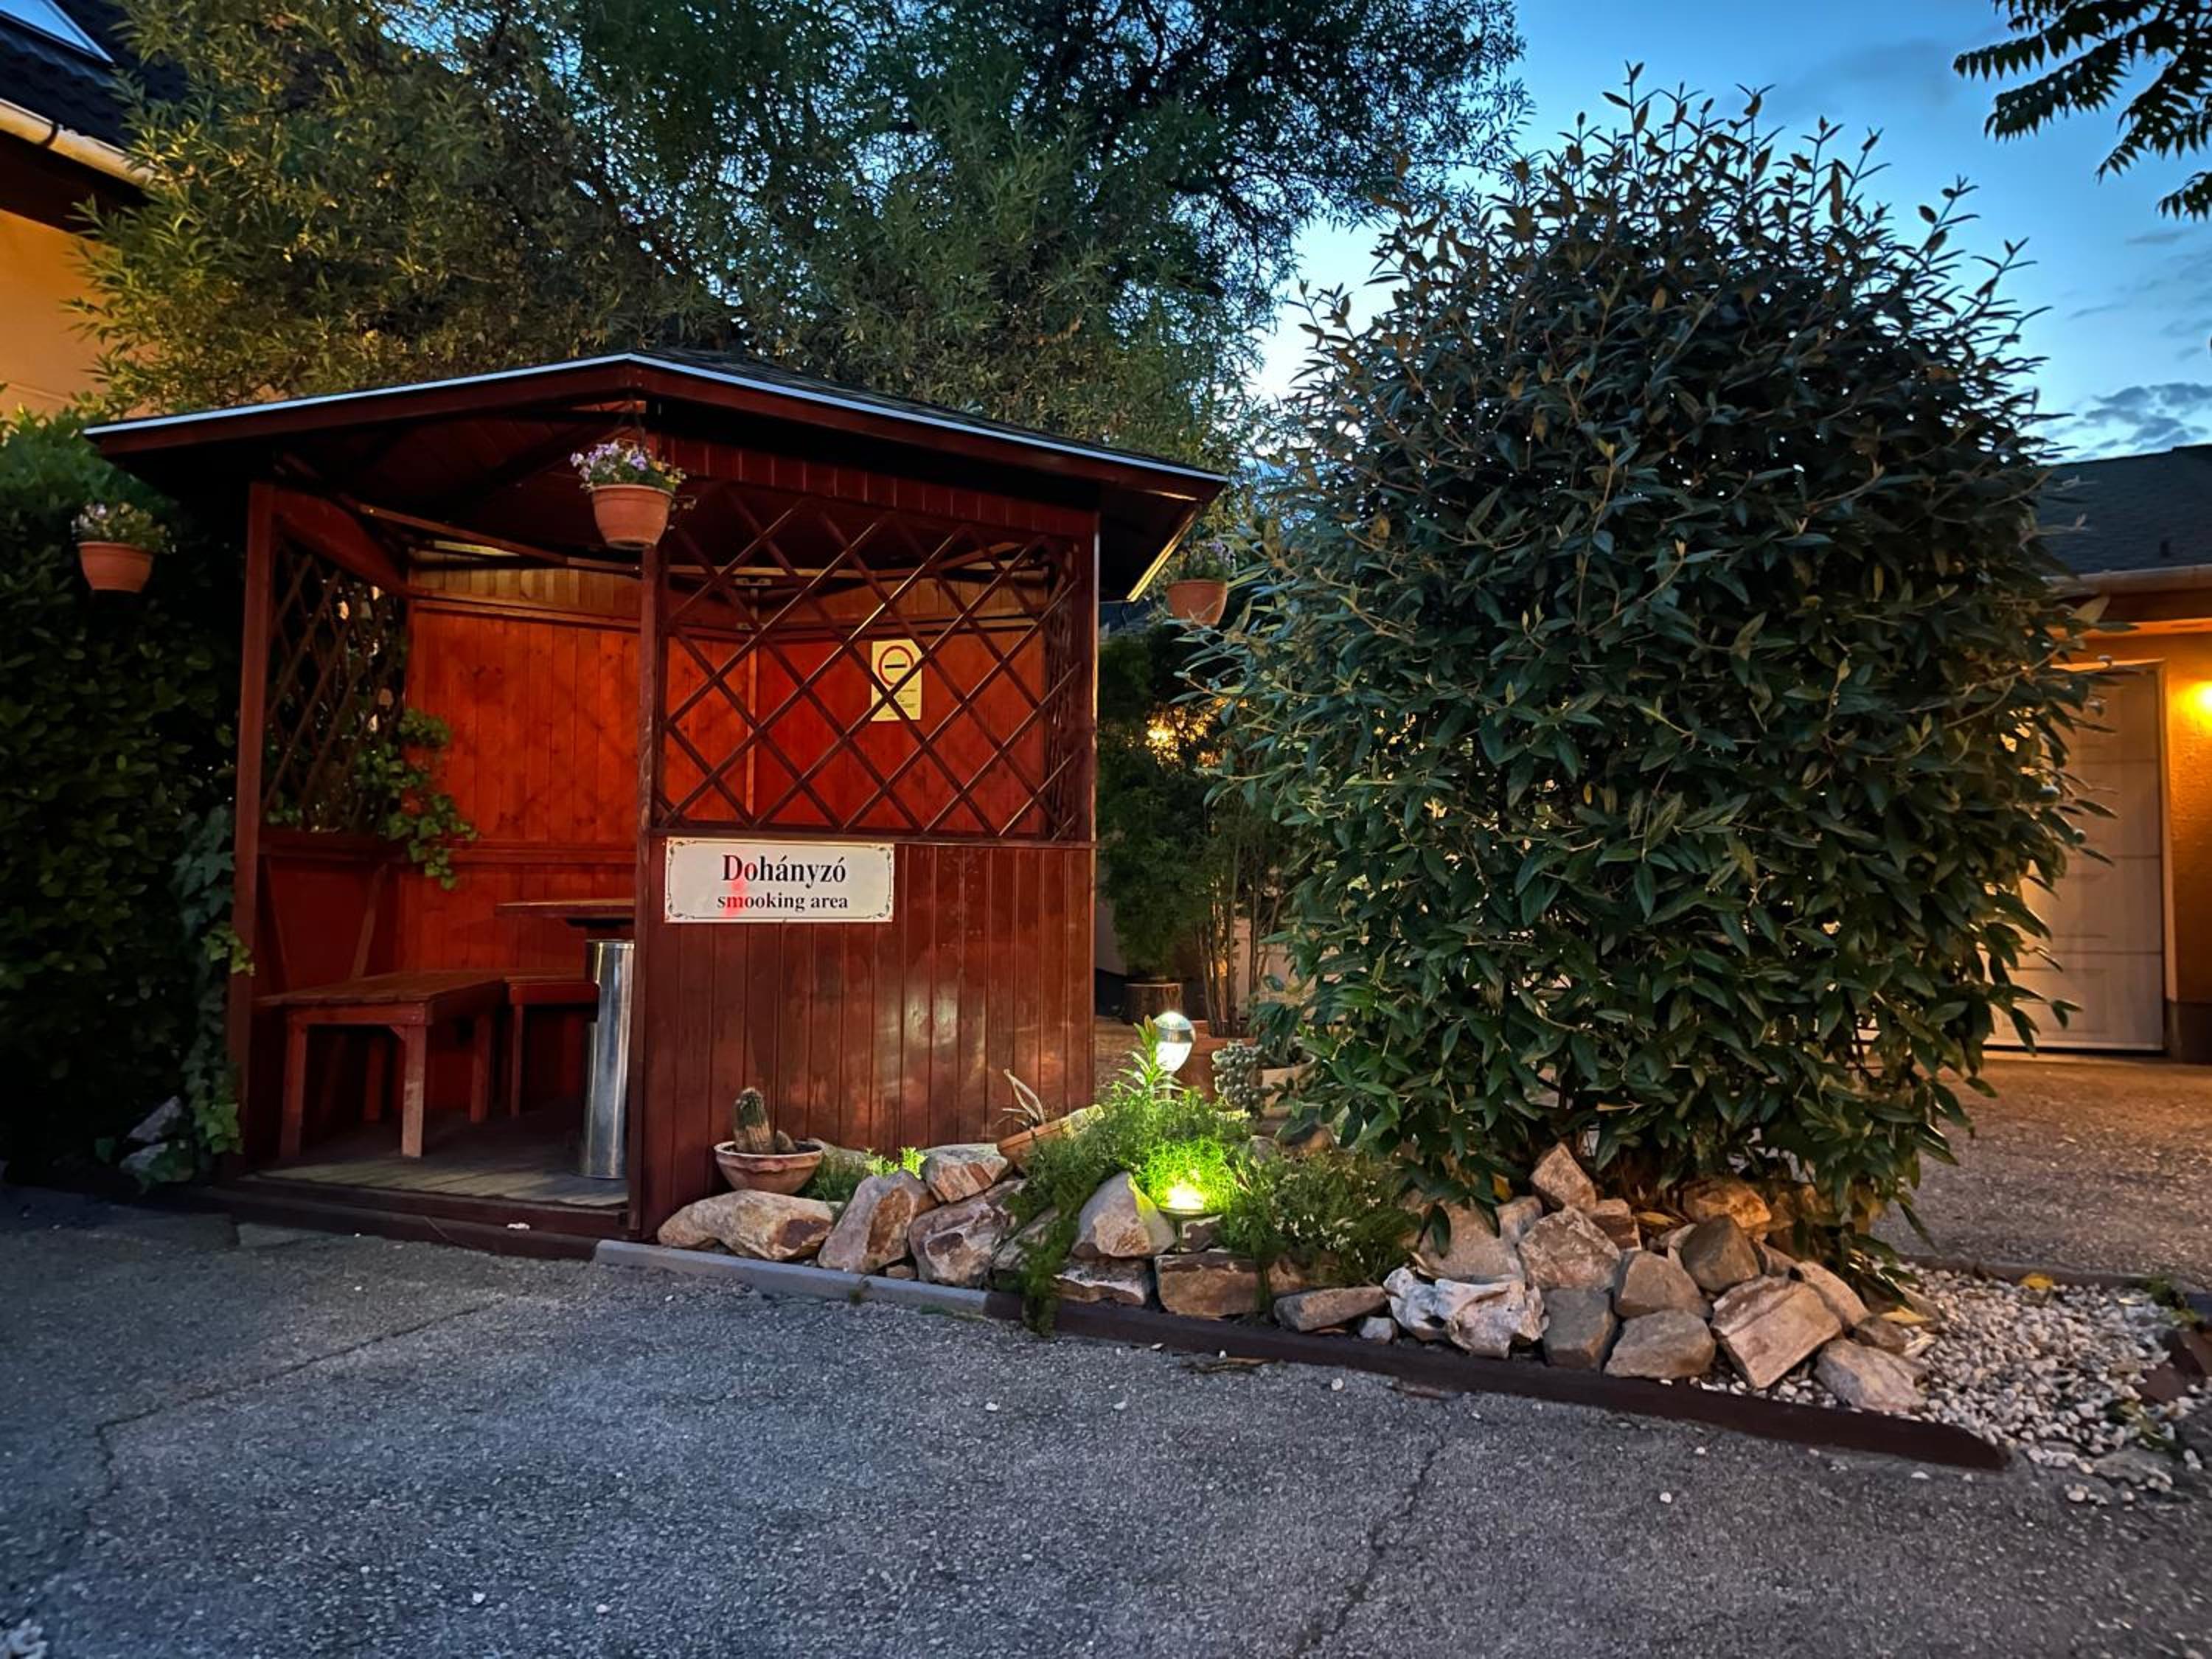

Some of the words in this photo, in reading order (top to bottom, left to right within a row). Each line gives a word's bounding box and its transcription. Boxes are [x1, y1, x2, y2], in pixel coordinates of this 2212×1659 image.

[721, 855, 846, 888] Dohányzó
[717, 892, 805, 911] smooking
[810, 895, 848, 909] area
